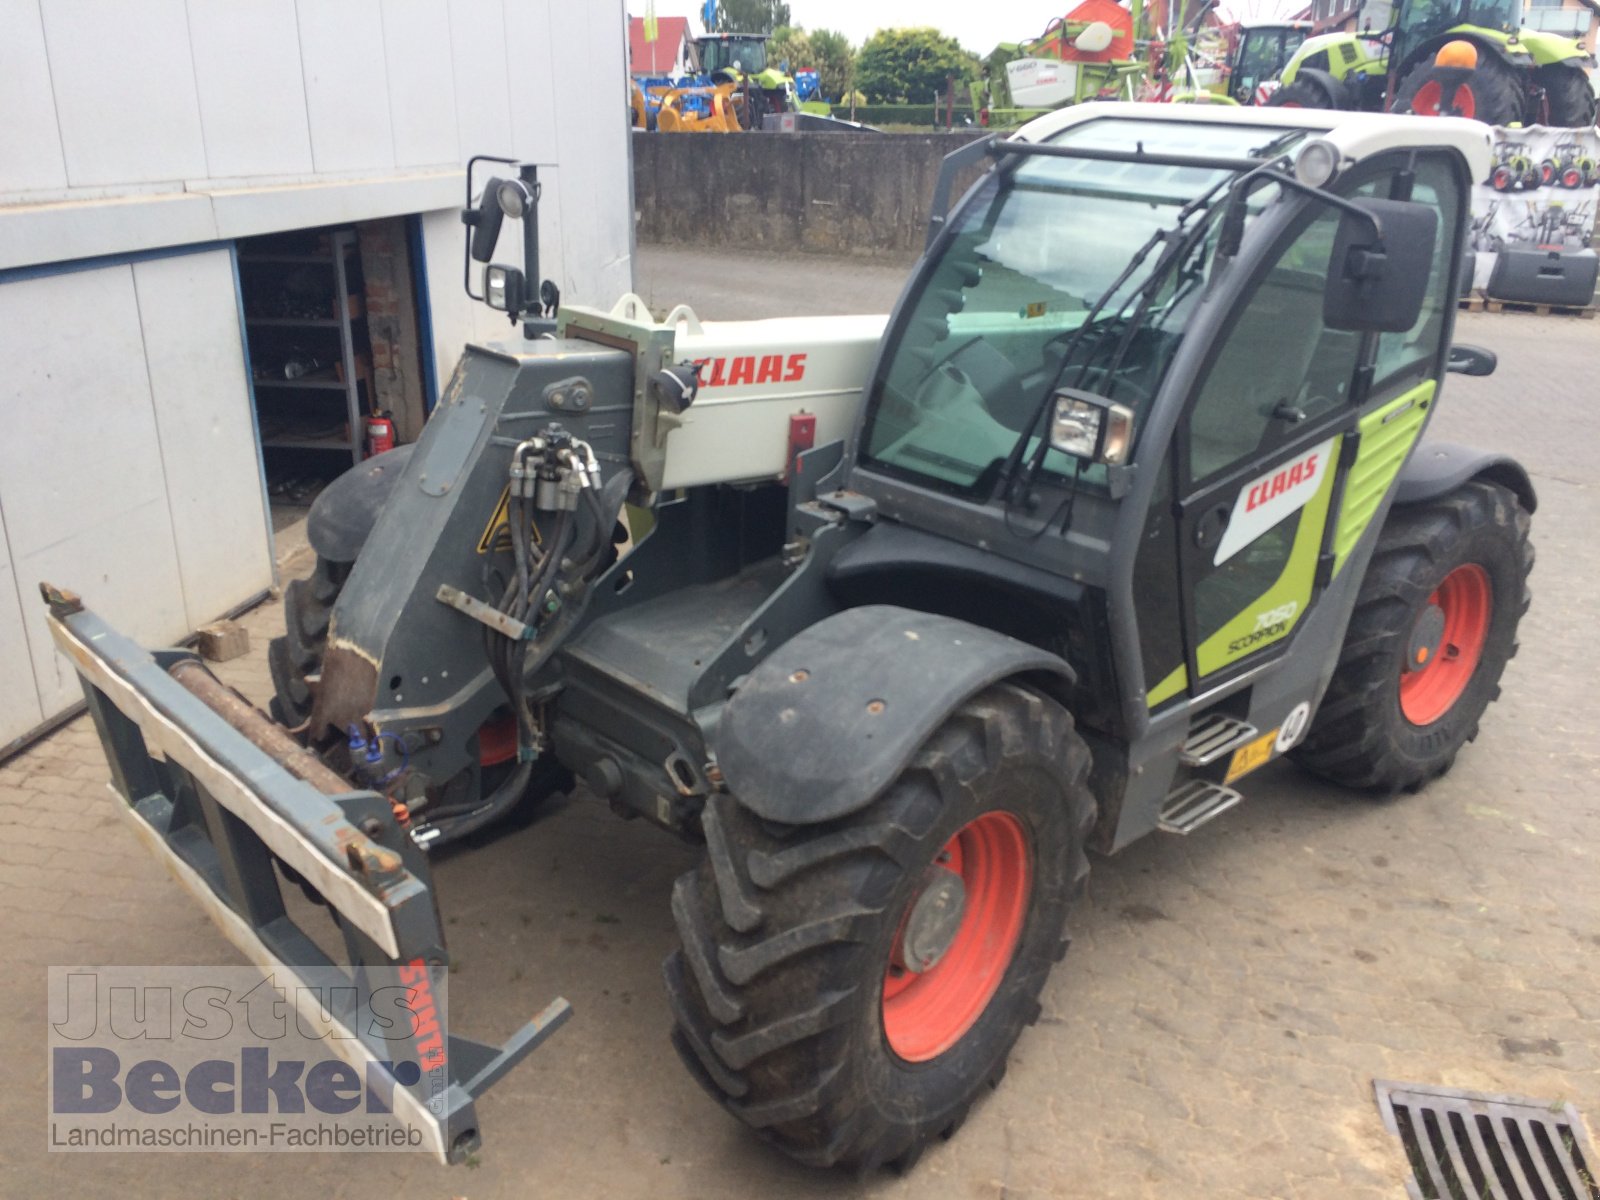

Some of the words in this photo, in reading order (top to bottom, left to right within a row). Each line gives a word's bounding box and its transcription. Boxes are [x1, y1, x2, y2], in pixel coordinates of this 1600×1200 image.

[694, 353, 807, 388] CLAAS
[1245, 453, 1318, 513] CLAAS
[1227, 622, 1287, 655] SCORPION
